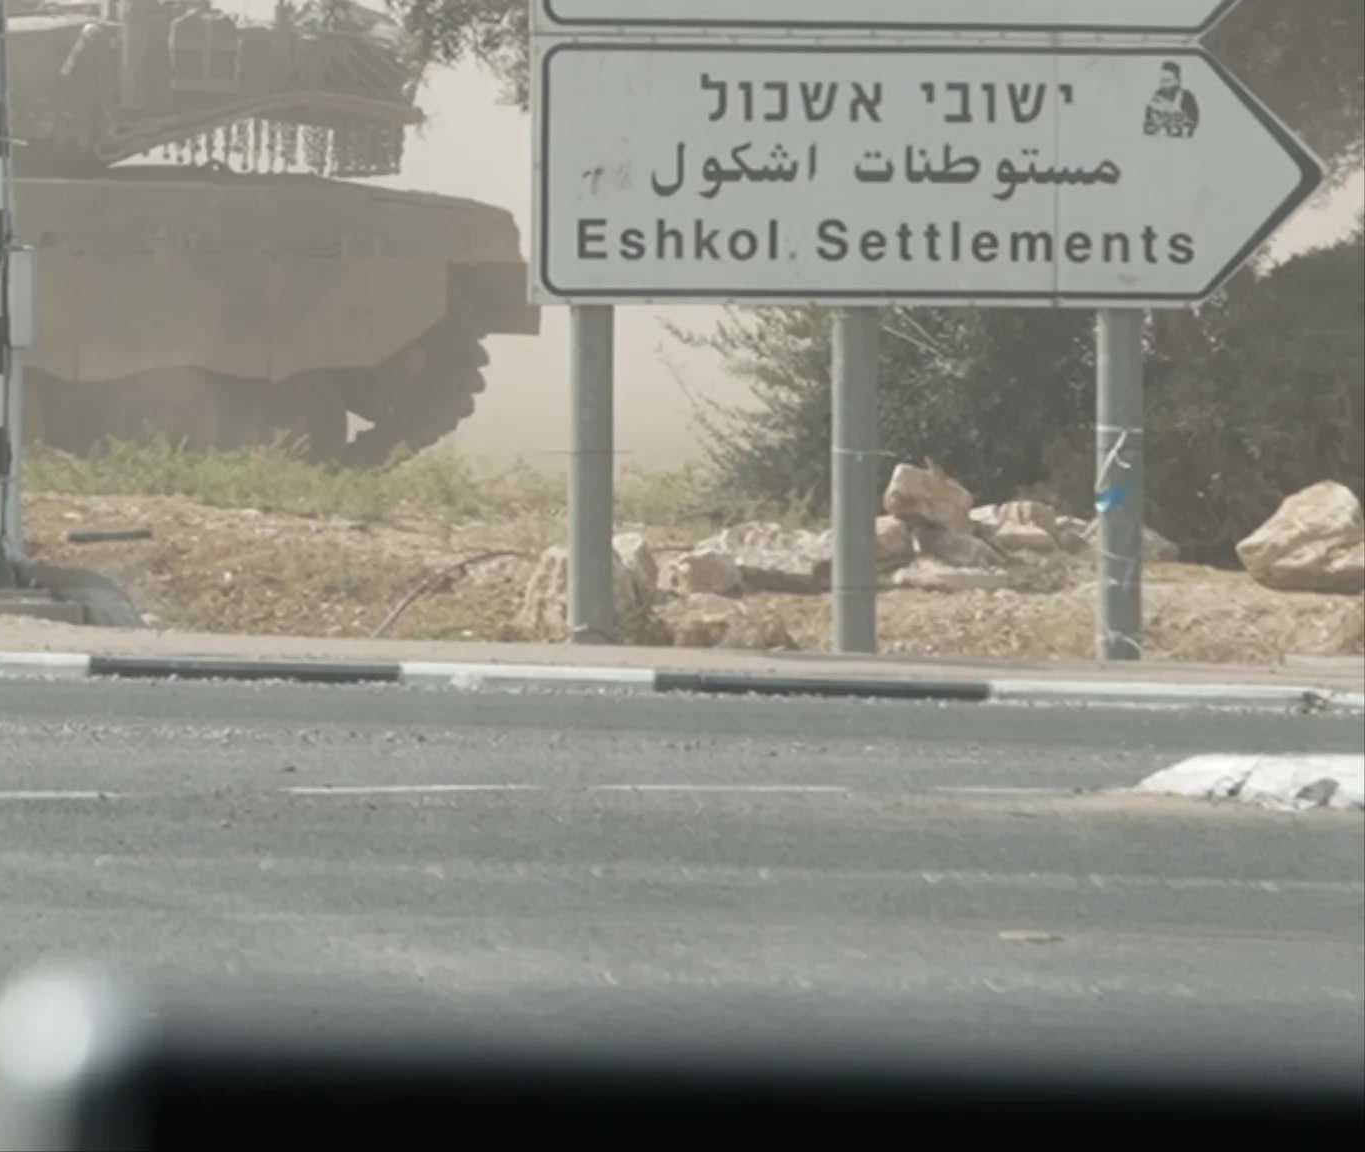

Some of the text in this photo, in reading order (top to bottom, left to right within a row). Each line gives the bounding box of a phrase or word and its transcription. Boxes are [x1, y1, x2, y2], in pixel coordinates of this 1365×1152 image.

[700, 72, 1073, 124] ישובי אשכול
[651, 141, 1121, 201] مستوطنات اشكول
[577, 218, 1195, 265] Eshkol Settlements
